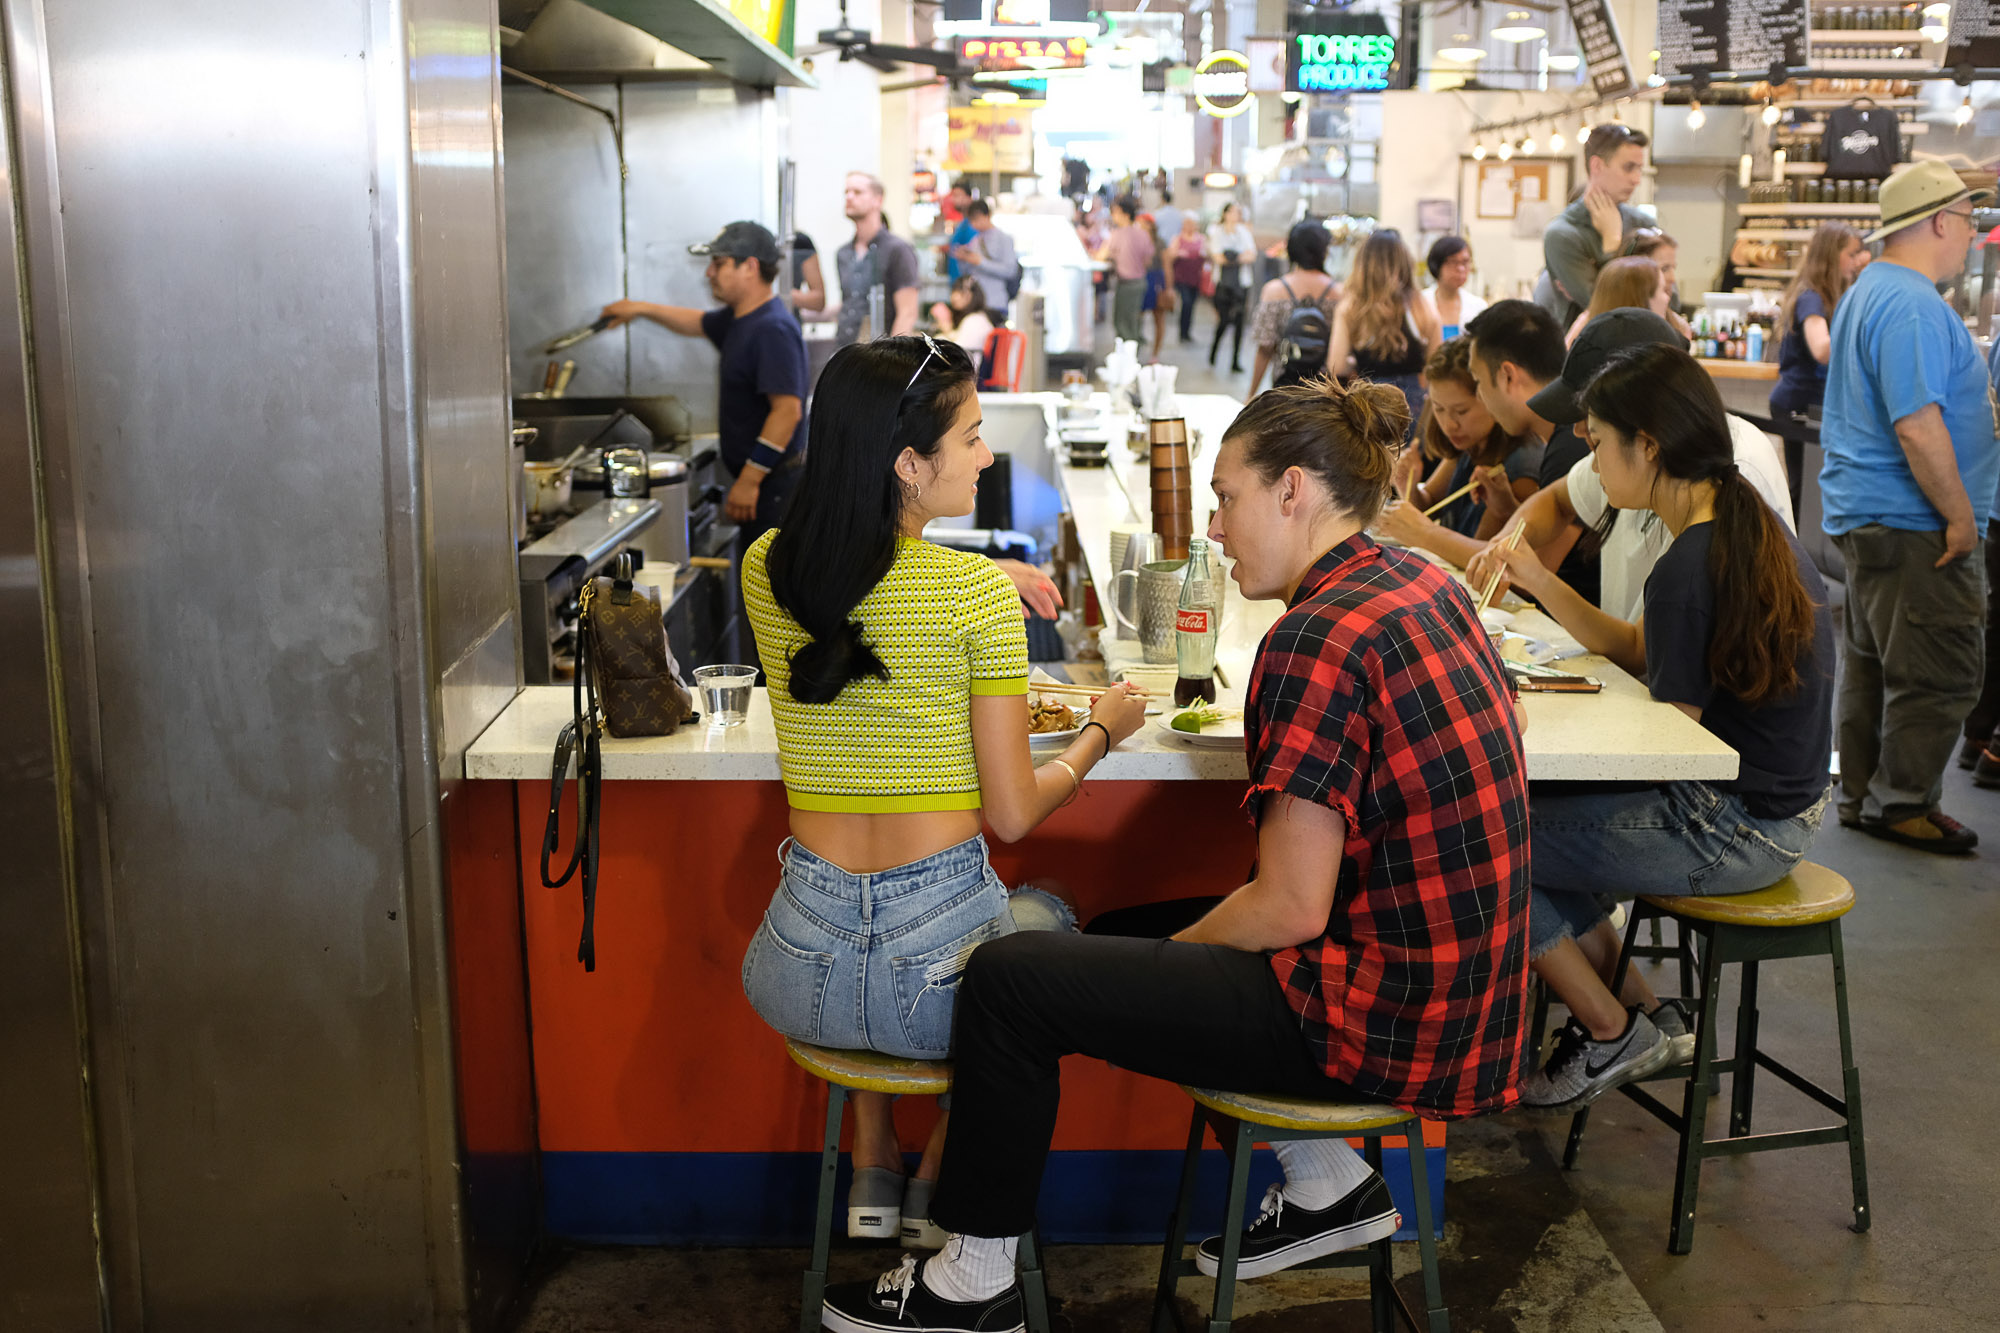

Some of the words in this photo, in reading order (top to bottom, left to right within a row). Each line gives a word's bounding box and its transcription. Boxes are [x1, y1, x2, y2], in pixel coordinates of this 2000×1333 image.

[963, 40, 1066, 59] PIZZA
[1296, 34, 1395, 65] TORRES
[1299, 63, 1390, 90] PRODUCE
